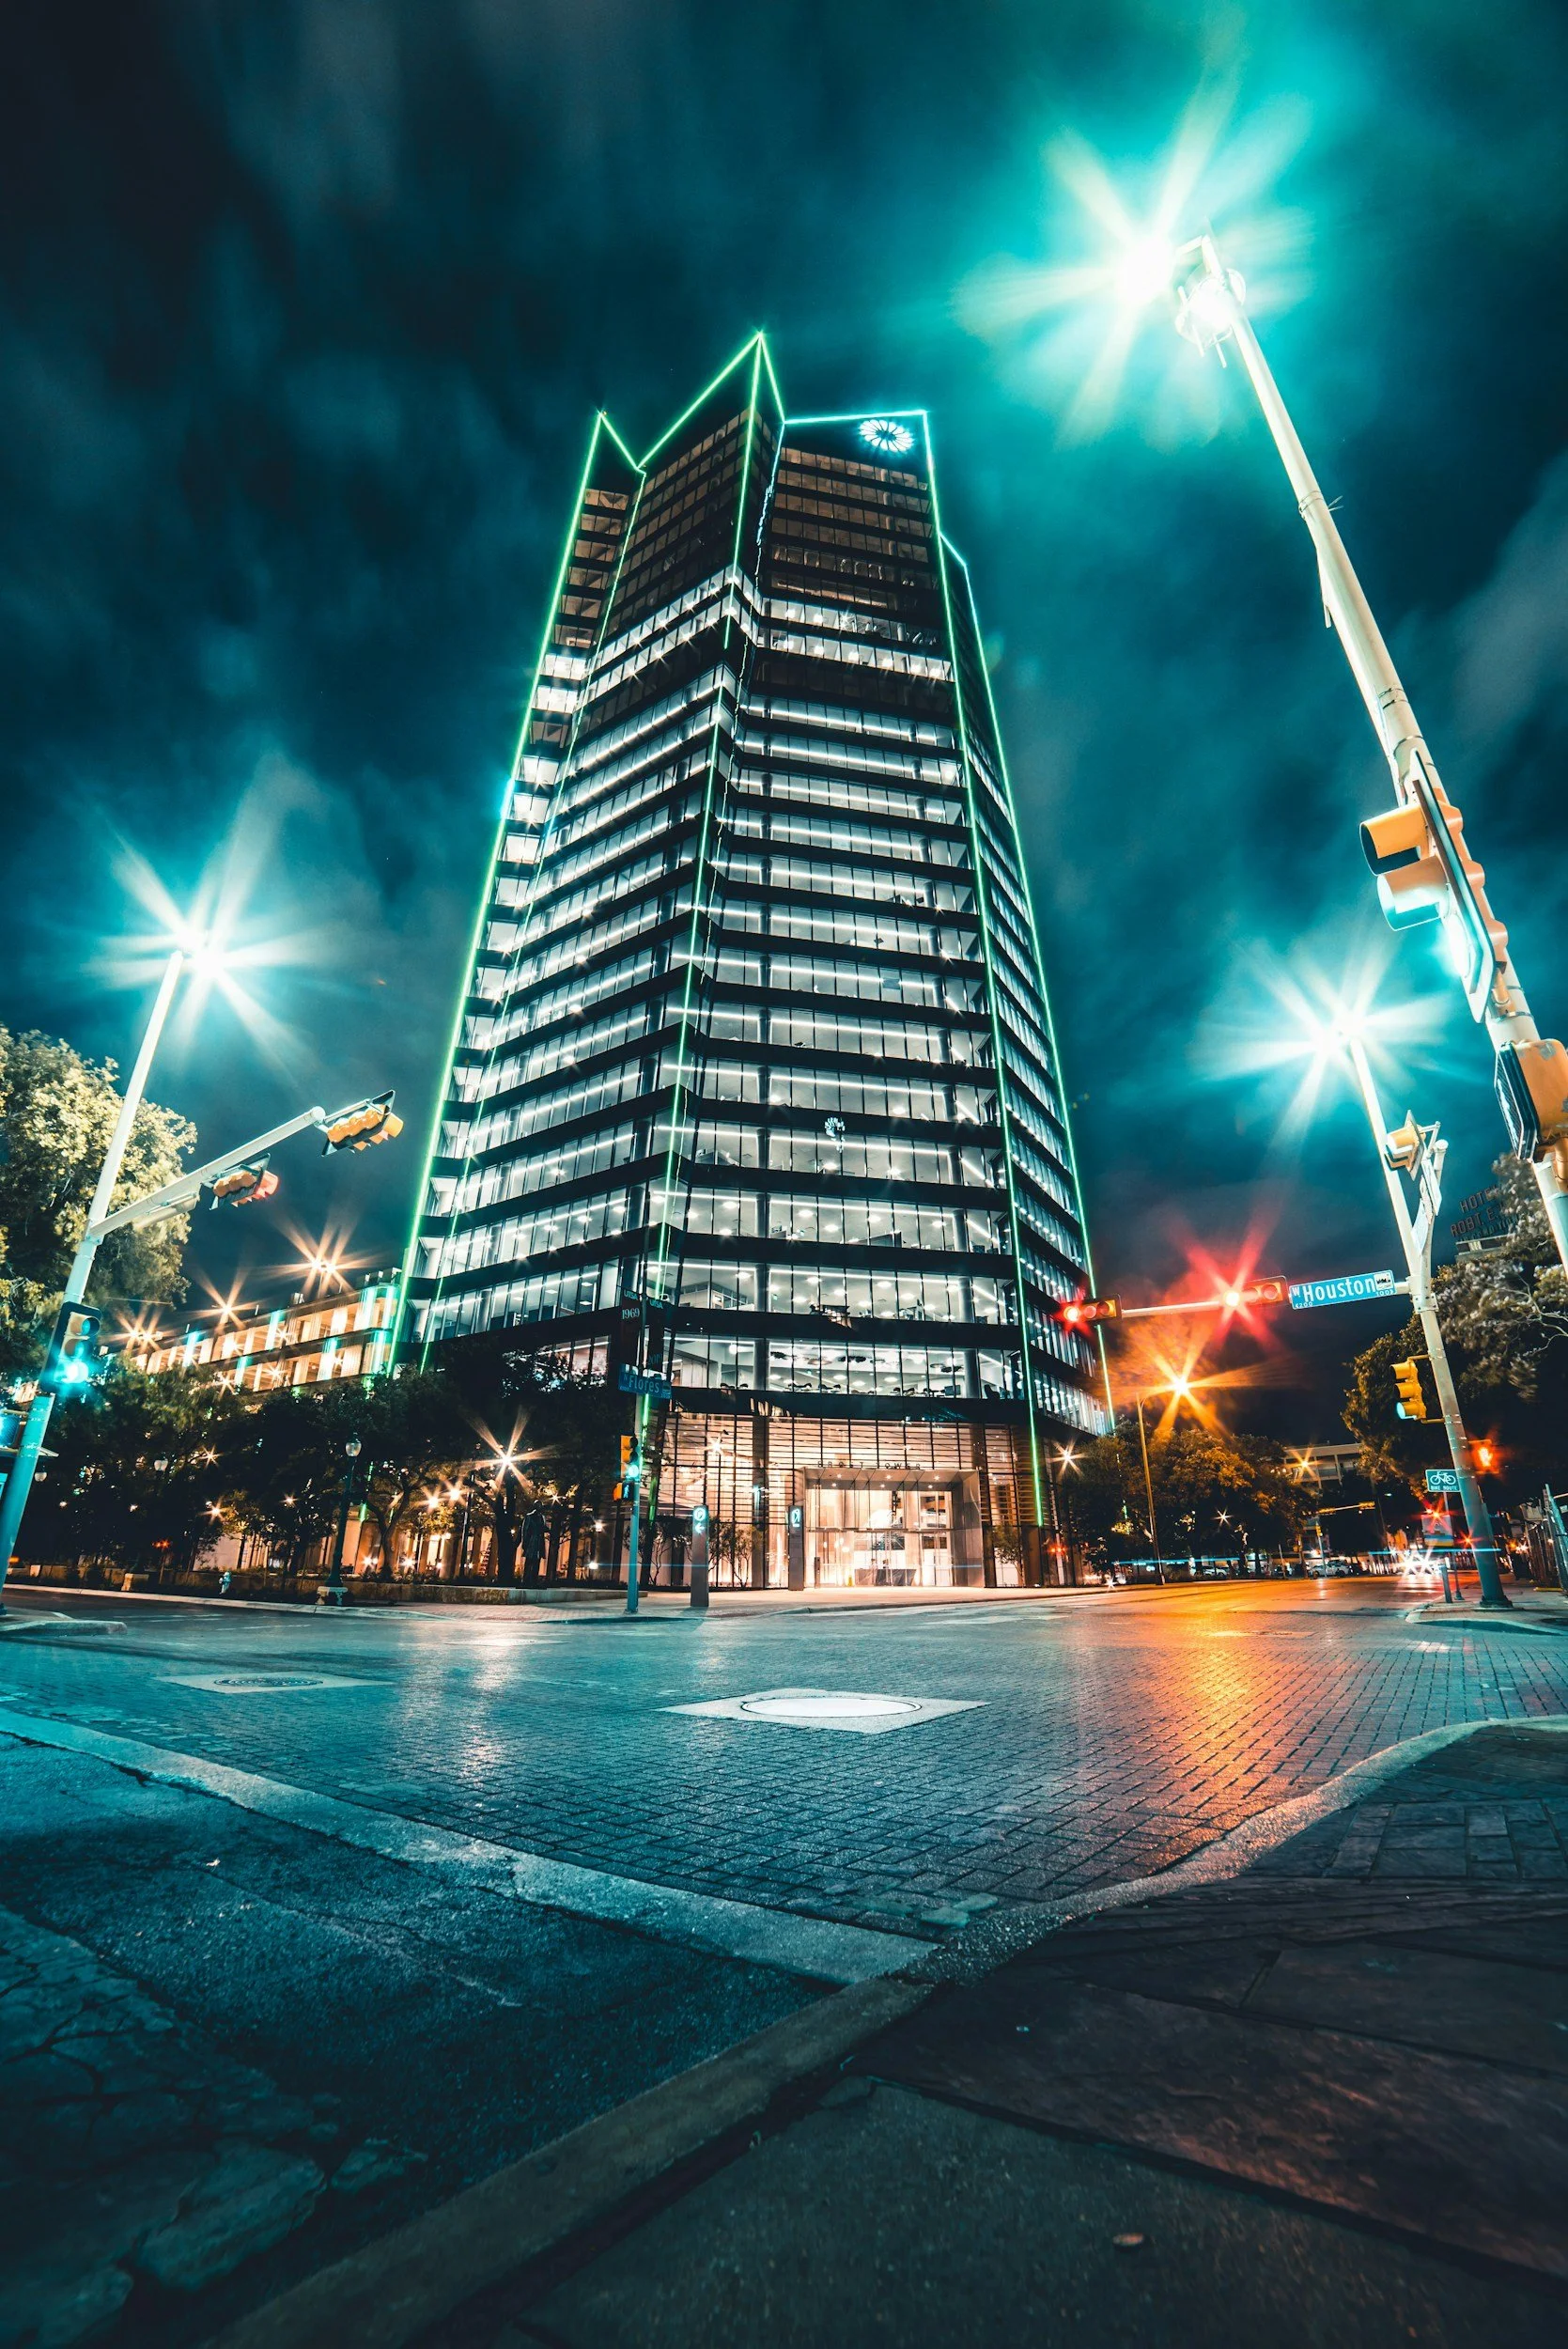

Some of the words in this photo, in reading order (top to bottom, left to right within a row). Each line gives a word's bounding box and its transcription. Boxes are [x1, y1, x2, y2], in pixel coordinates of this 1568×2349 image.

[1302, 1278, 1376, 1303] Houston
[622, 1308, 640, 1320] 1969
[629, 1374, 660, 1393] Flores
